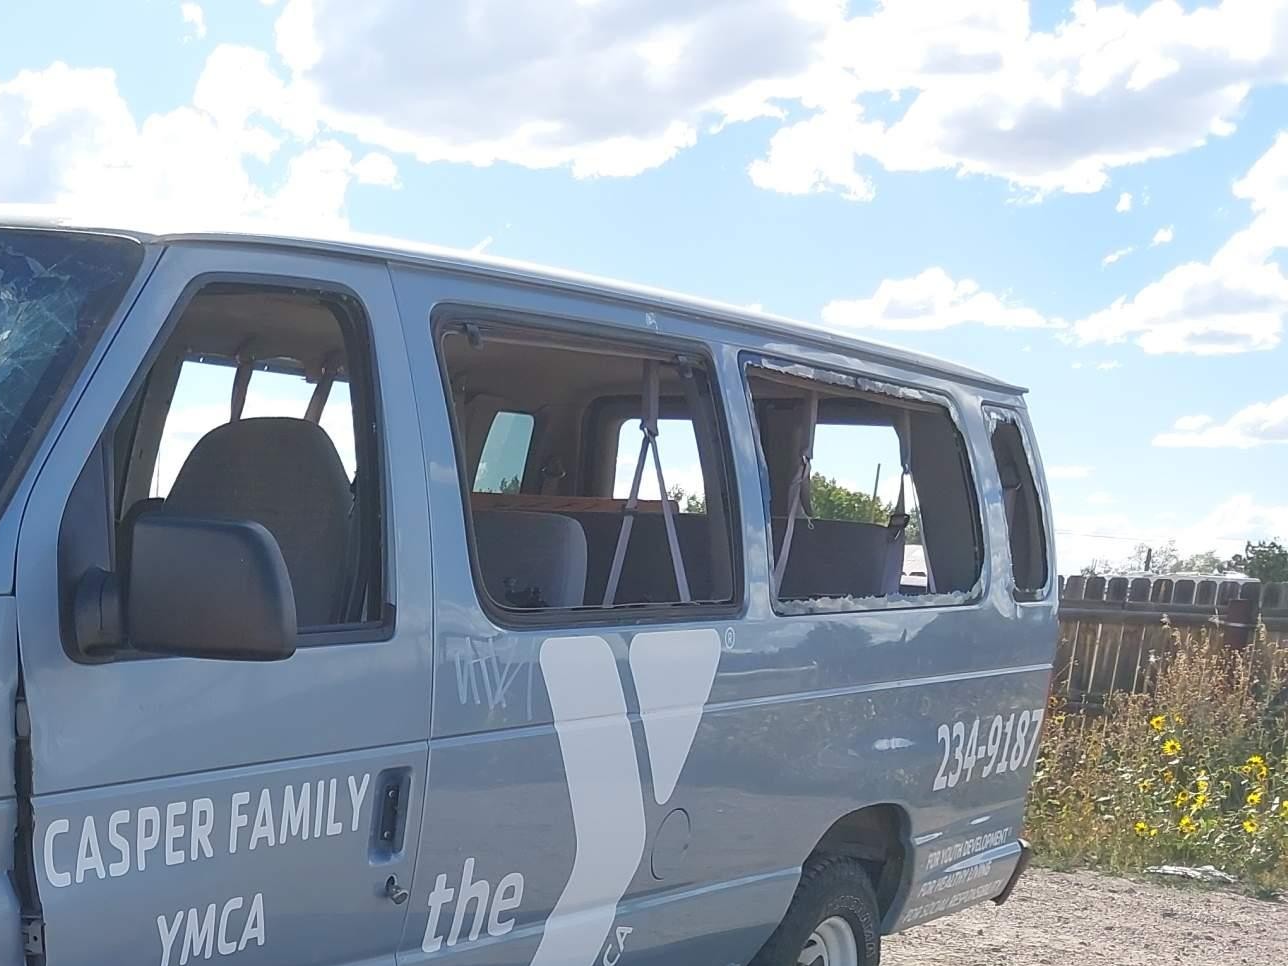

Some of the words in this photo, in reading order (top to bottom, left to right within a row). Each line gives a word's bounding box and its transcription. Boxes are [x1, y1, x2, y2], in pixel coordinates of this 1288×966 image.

[932, 708, 1045, 791] 234-9187
[43, 797, 214, 889] CASPER
[229, 773, 371, 854] FAMILY
[421, 857, 525, 953] the
